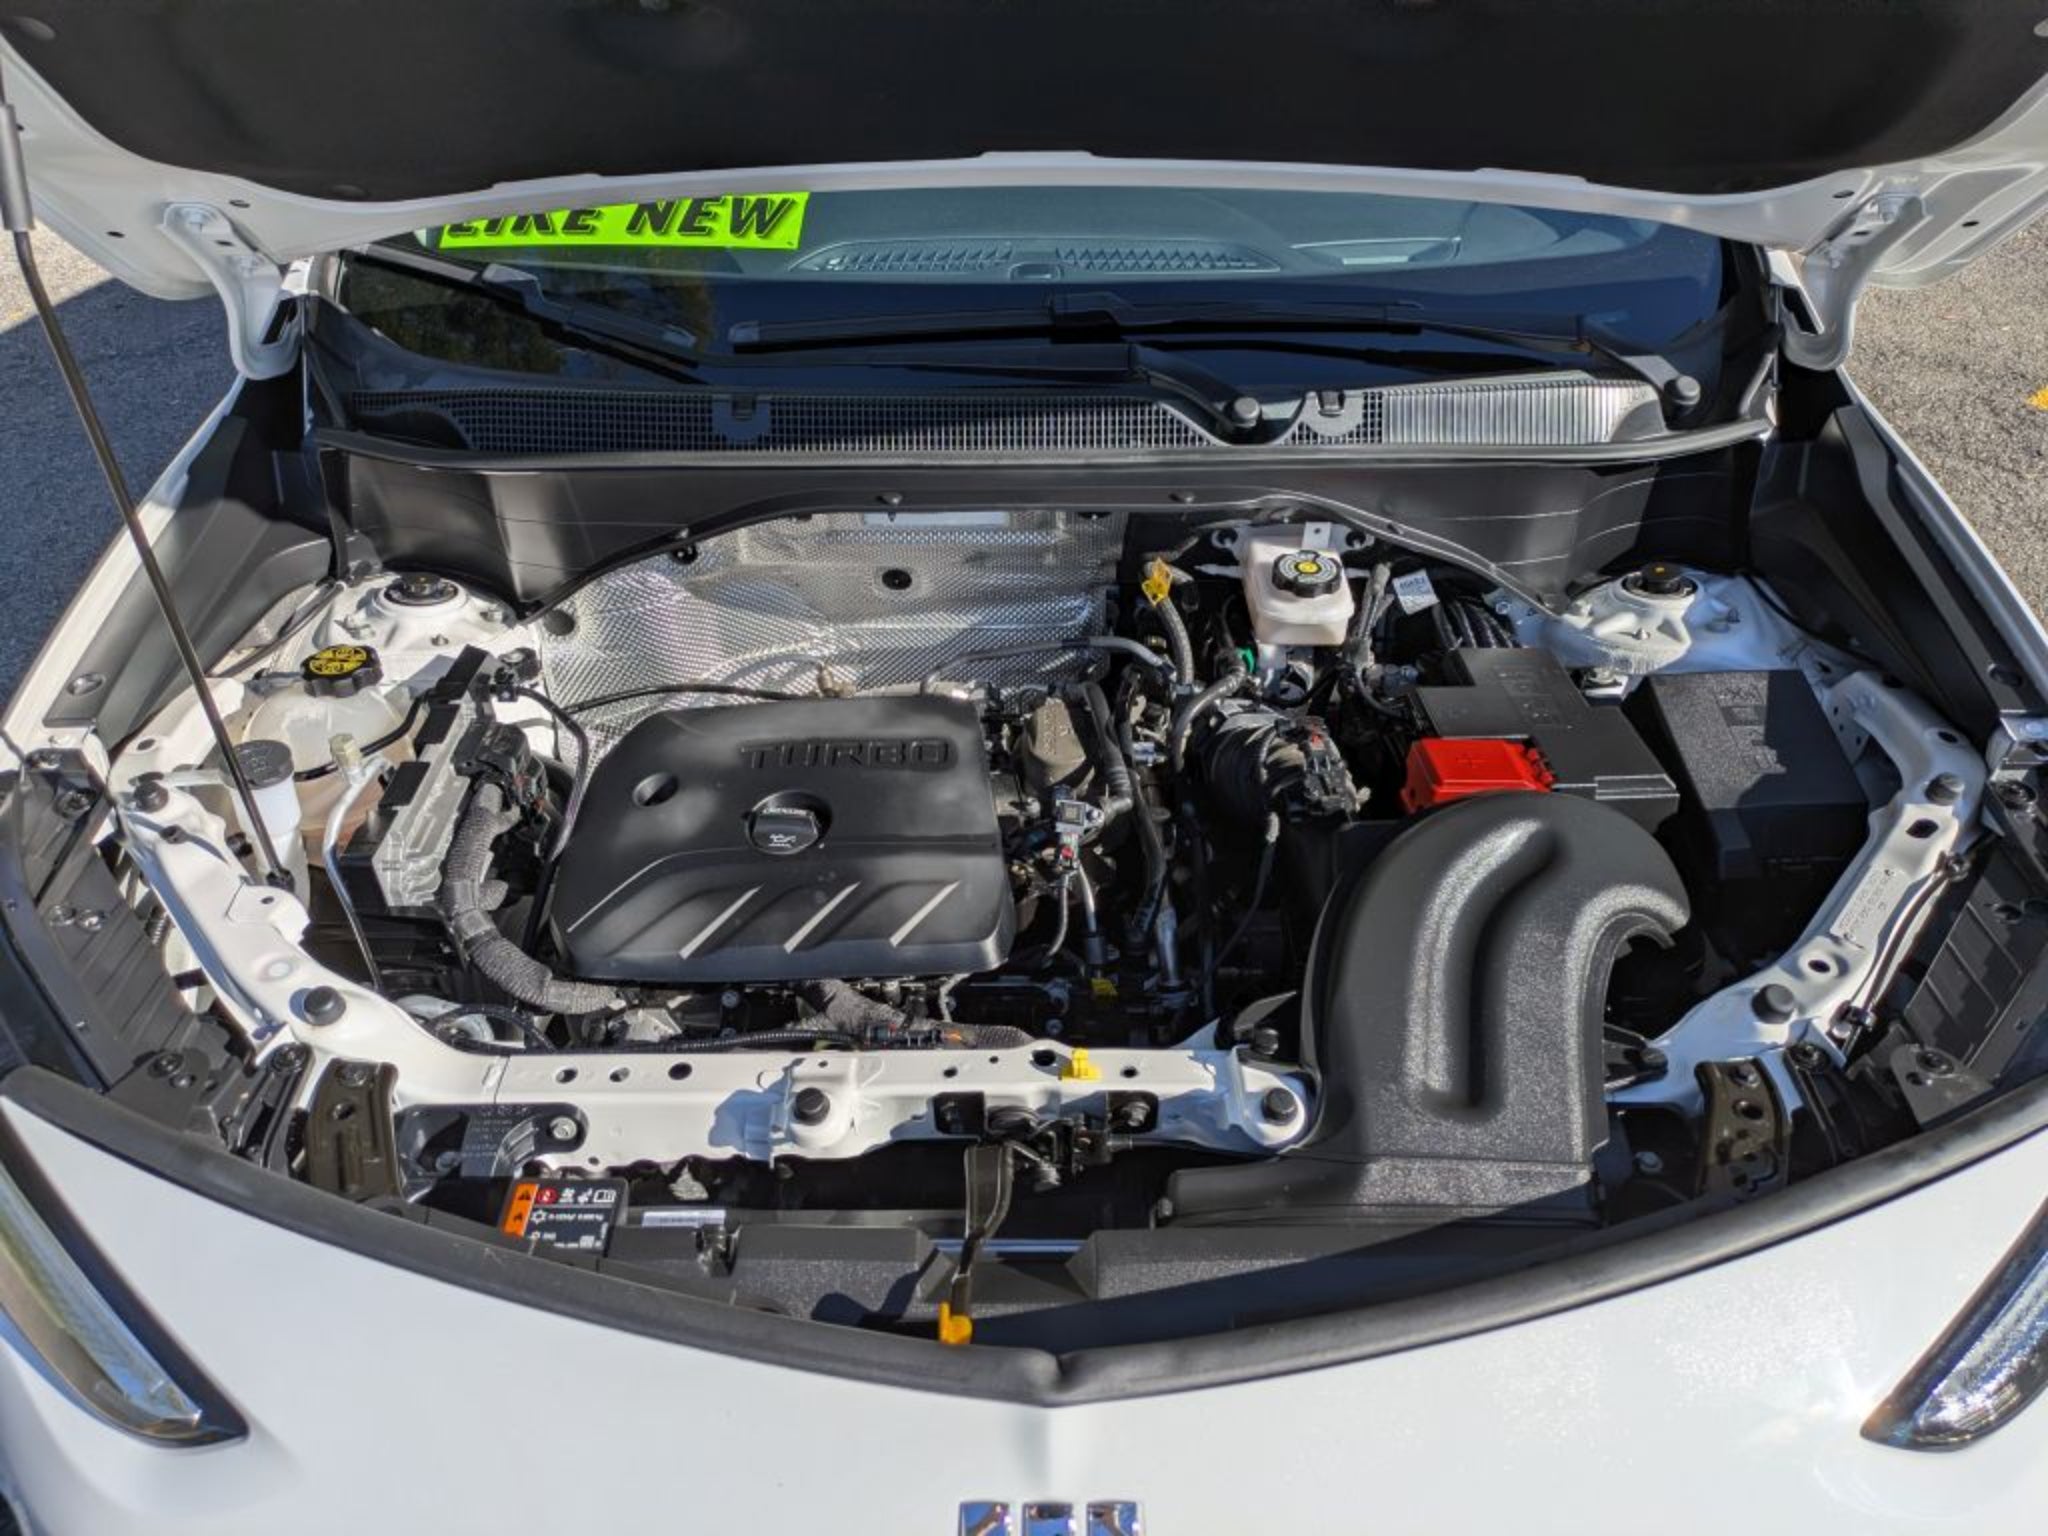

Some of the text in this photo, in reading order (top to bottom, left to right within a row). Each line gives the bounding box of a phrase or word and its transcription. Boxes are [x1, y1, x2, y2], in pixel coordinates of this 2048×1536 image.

[447, 197, 796, 237] KE NEW
[740, 740, 950, 769] TURBO
